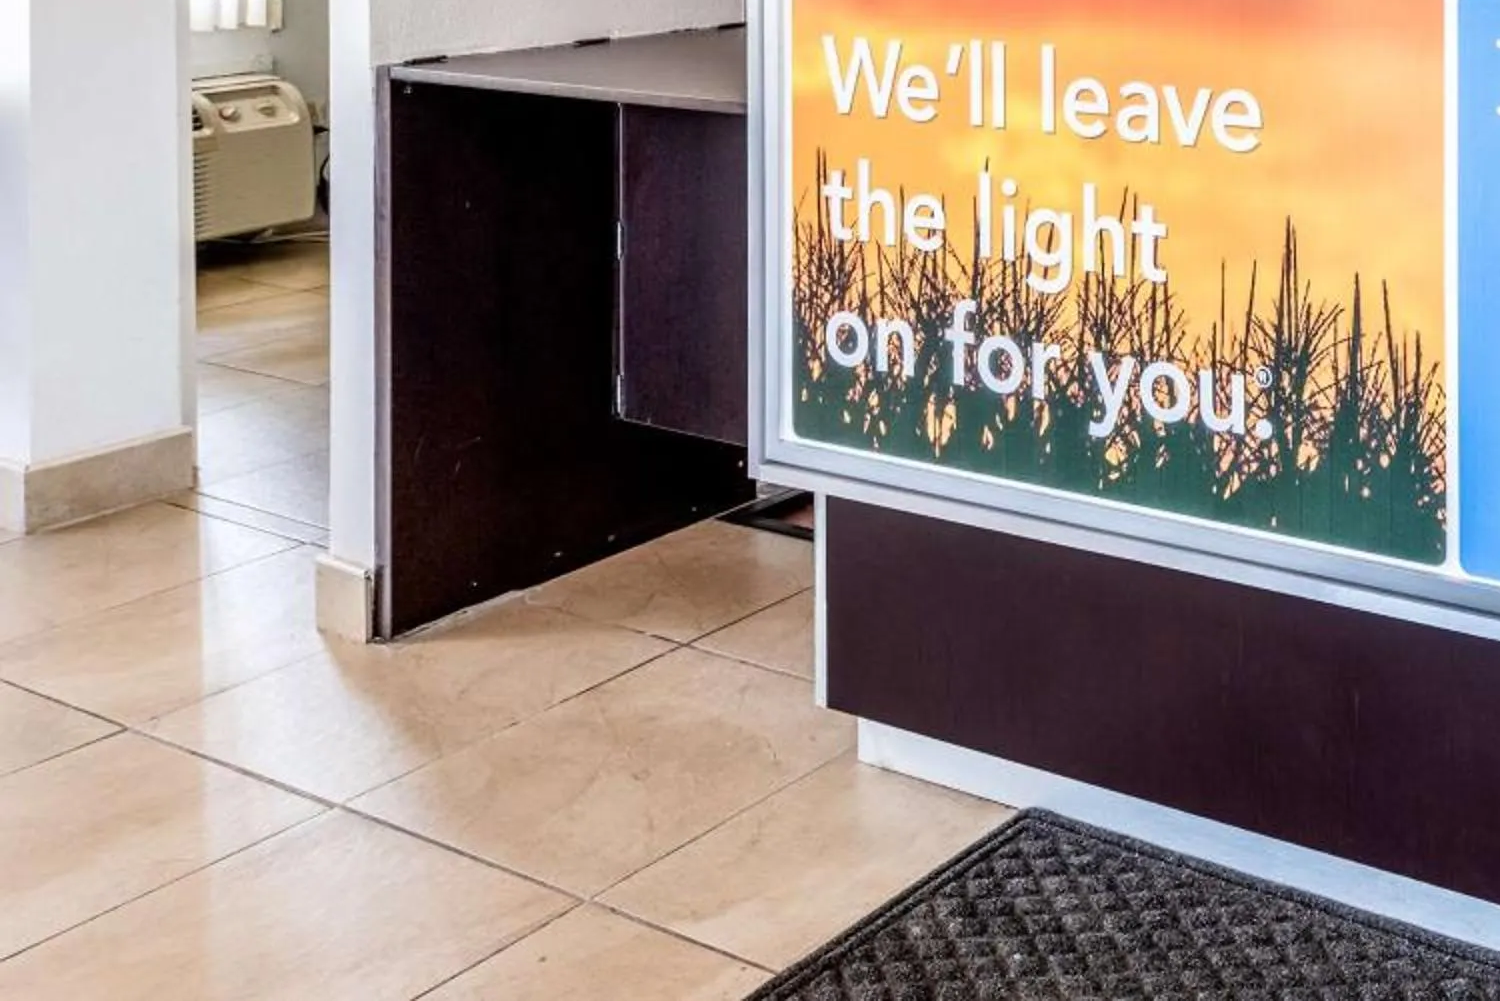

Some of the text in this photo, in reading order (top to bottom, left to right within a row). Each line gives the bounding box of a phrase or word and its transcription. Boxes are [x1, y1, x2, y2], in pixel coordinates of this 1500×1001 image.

[822, 35, 1264, 152] We'll leave
[823, 157, 1168, 295] the light
[825, 309, 915, 376] on
[945, 298, 1060, 398] for
